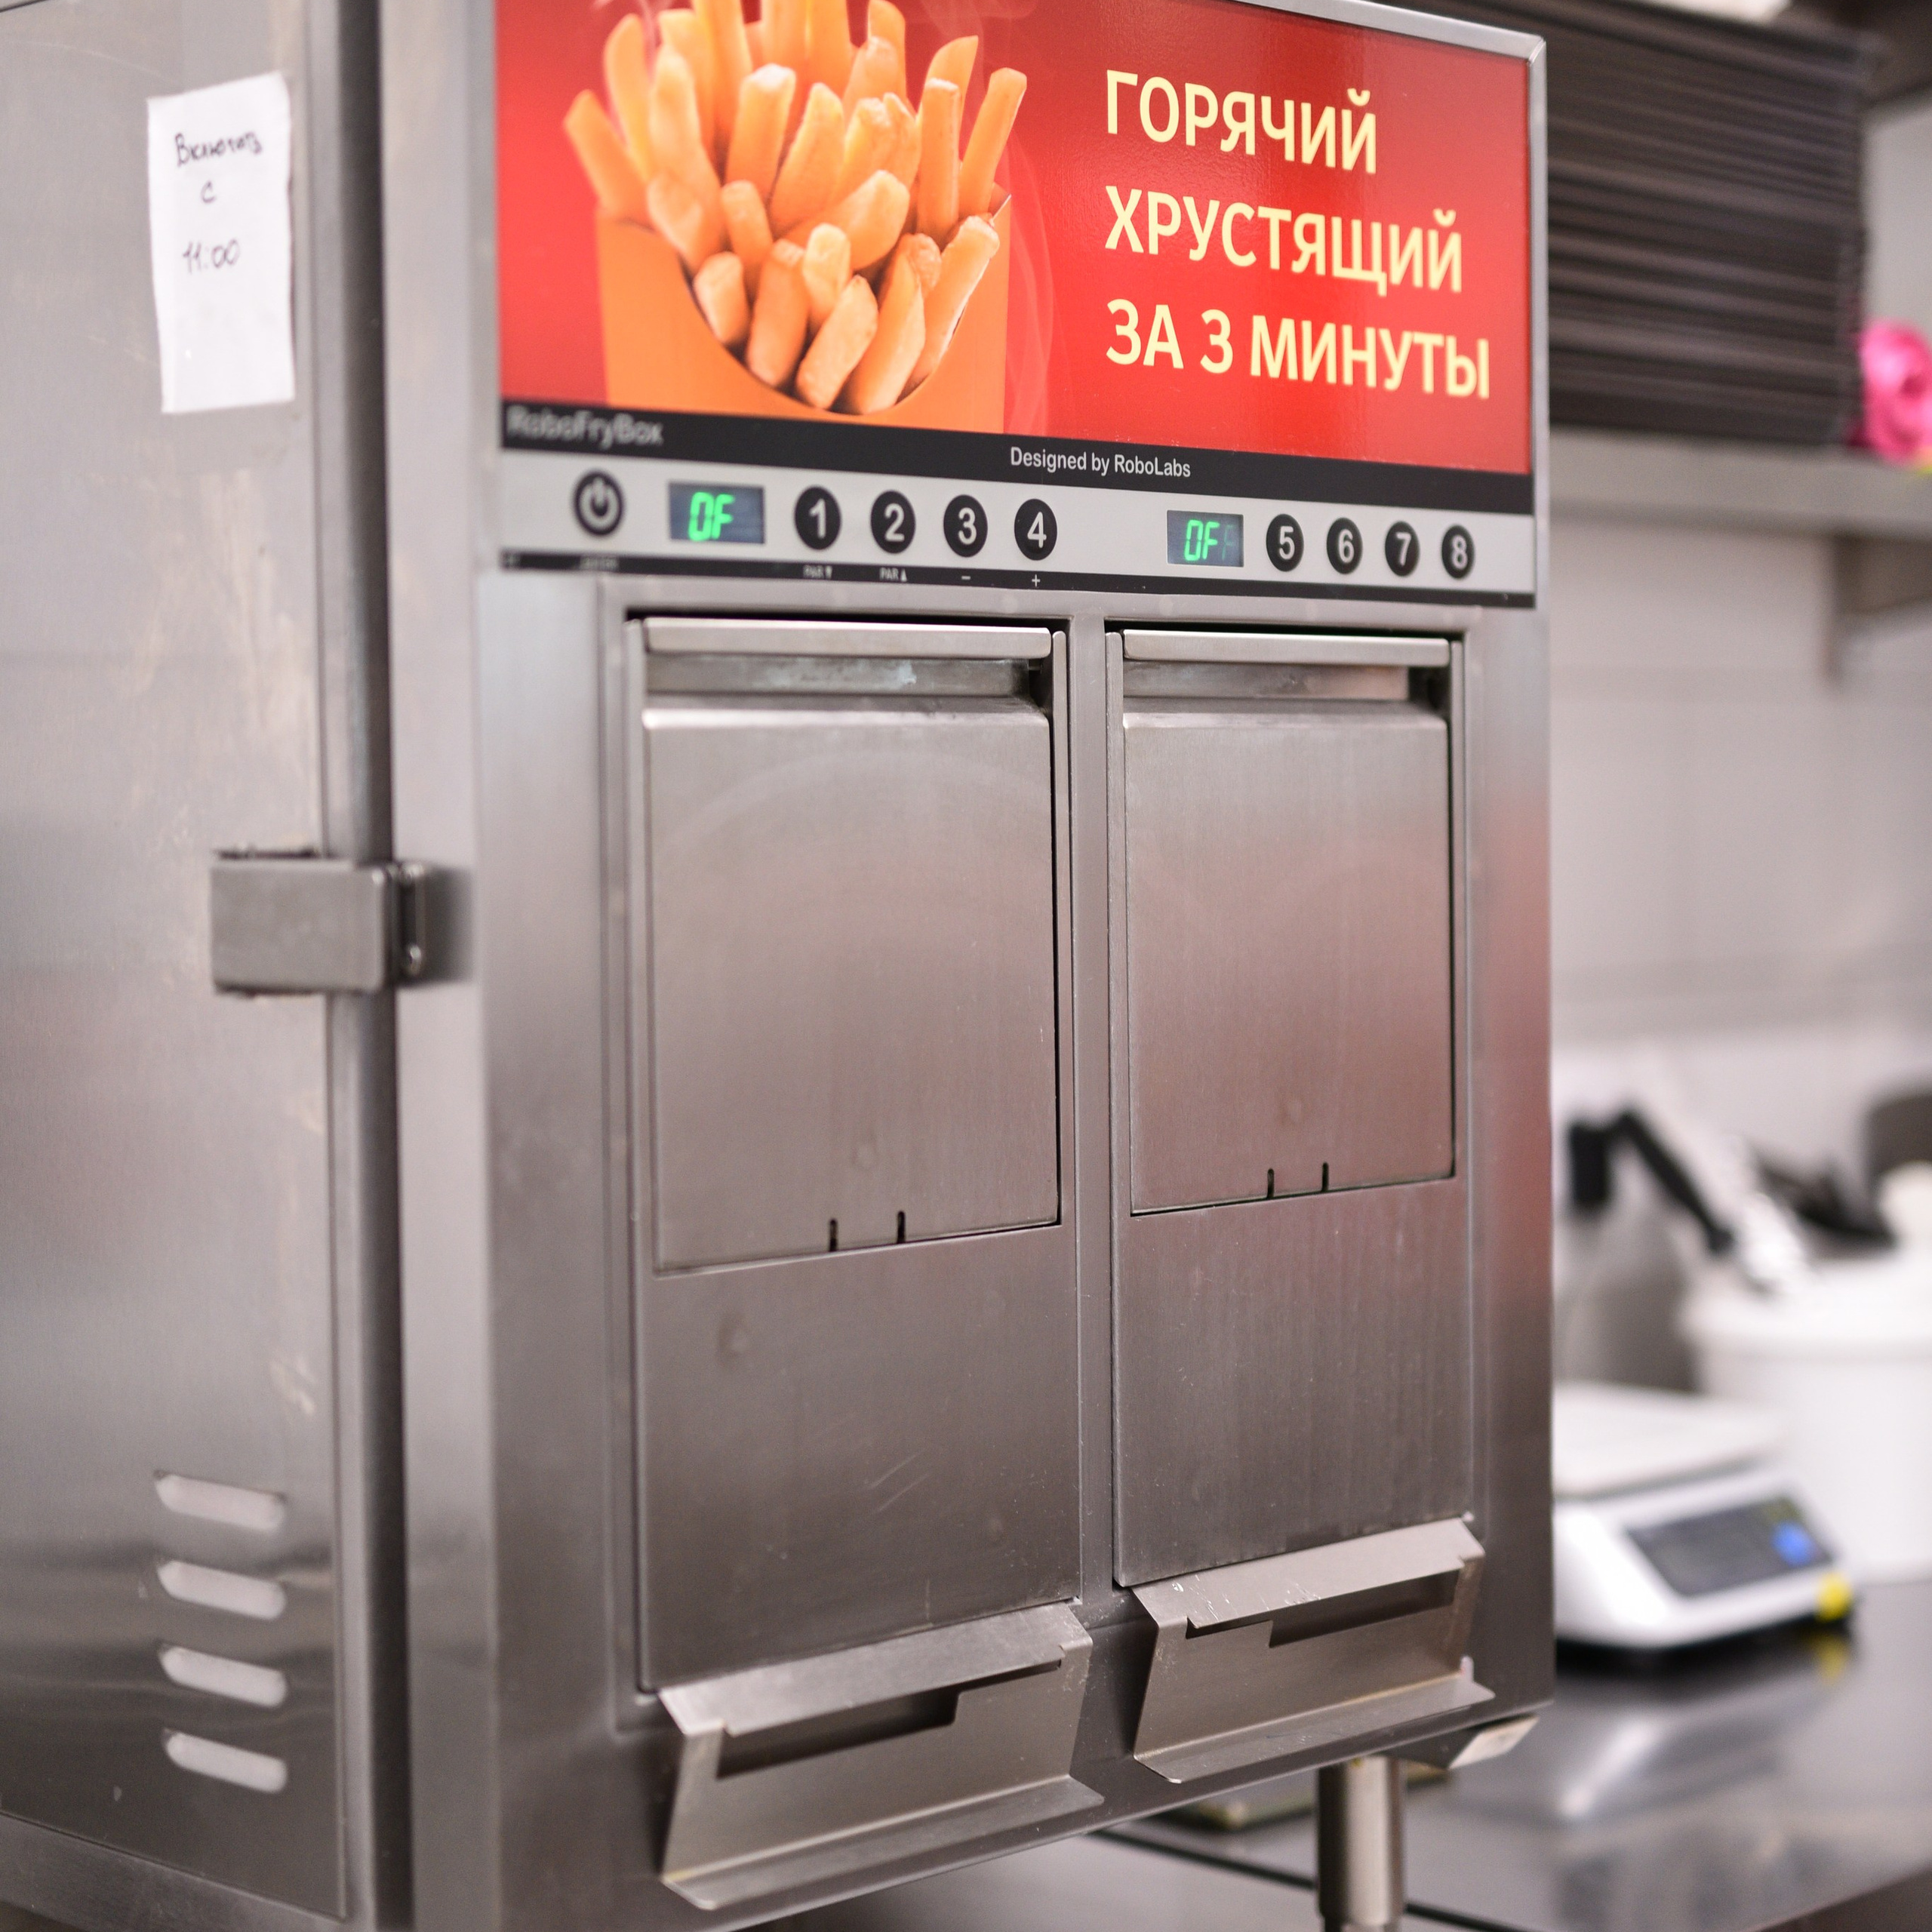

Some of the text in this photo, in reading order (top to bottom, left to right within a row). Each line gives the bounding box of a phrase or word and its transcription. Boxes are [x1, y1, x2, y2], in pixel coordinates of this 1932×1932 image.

[1107, 69, 1377, 174] ГОРЯЧИЙ
[1105, 185, 1462, 297] ХРУСТЯЩИЙ
[1106, 299, 1490, 398] ЗА 3 МИНУТЫ
[505, 405, 664, 450] RoboFryBox
[1011, 446, 1191, 478] Designed by RoboLabs
[810, 499, 827, 537] 1
[884, 503, 905, 541] 2
[958, 507, 977, 545] 3
[1027, 512, 1048, 549] 4
[1278, 526, 1294, 560] 5
[1339, 530, 1355, 565] 6
[1396, 532, 1411, 566] 7
[1451, 535, 1468, 569] 8
